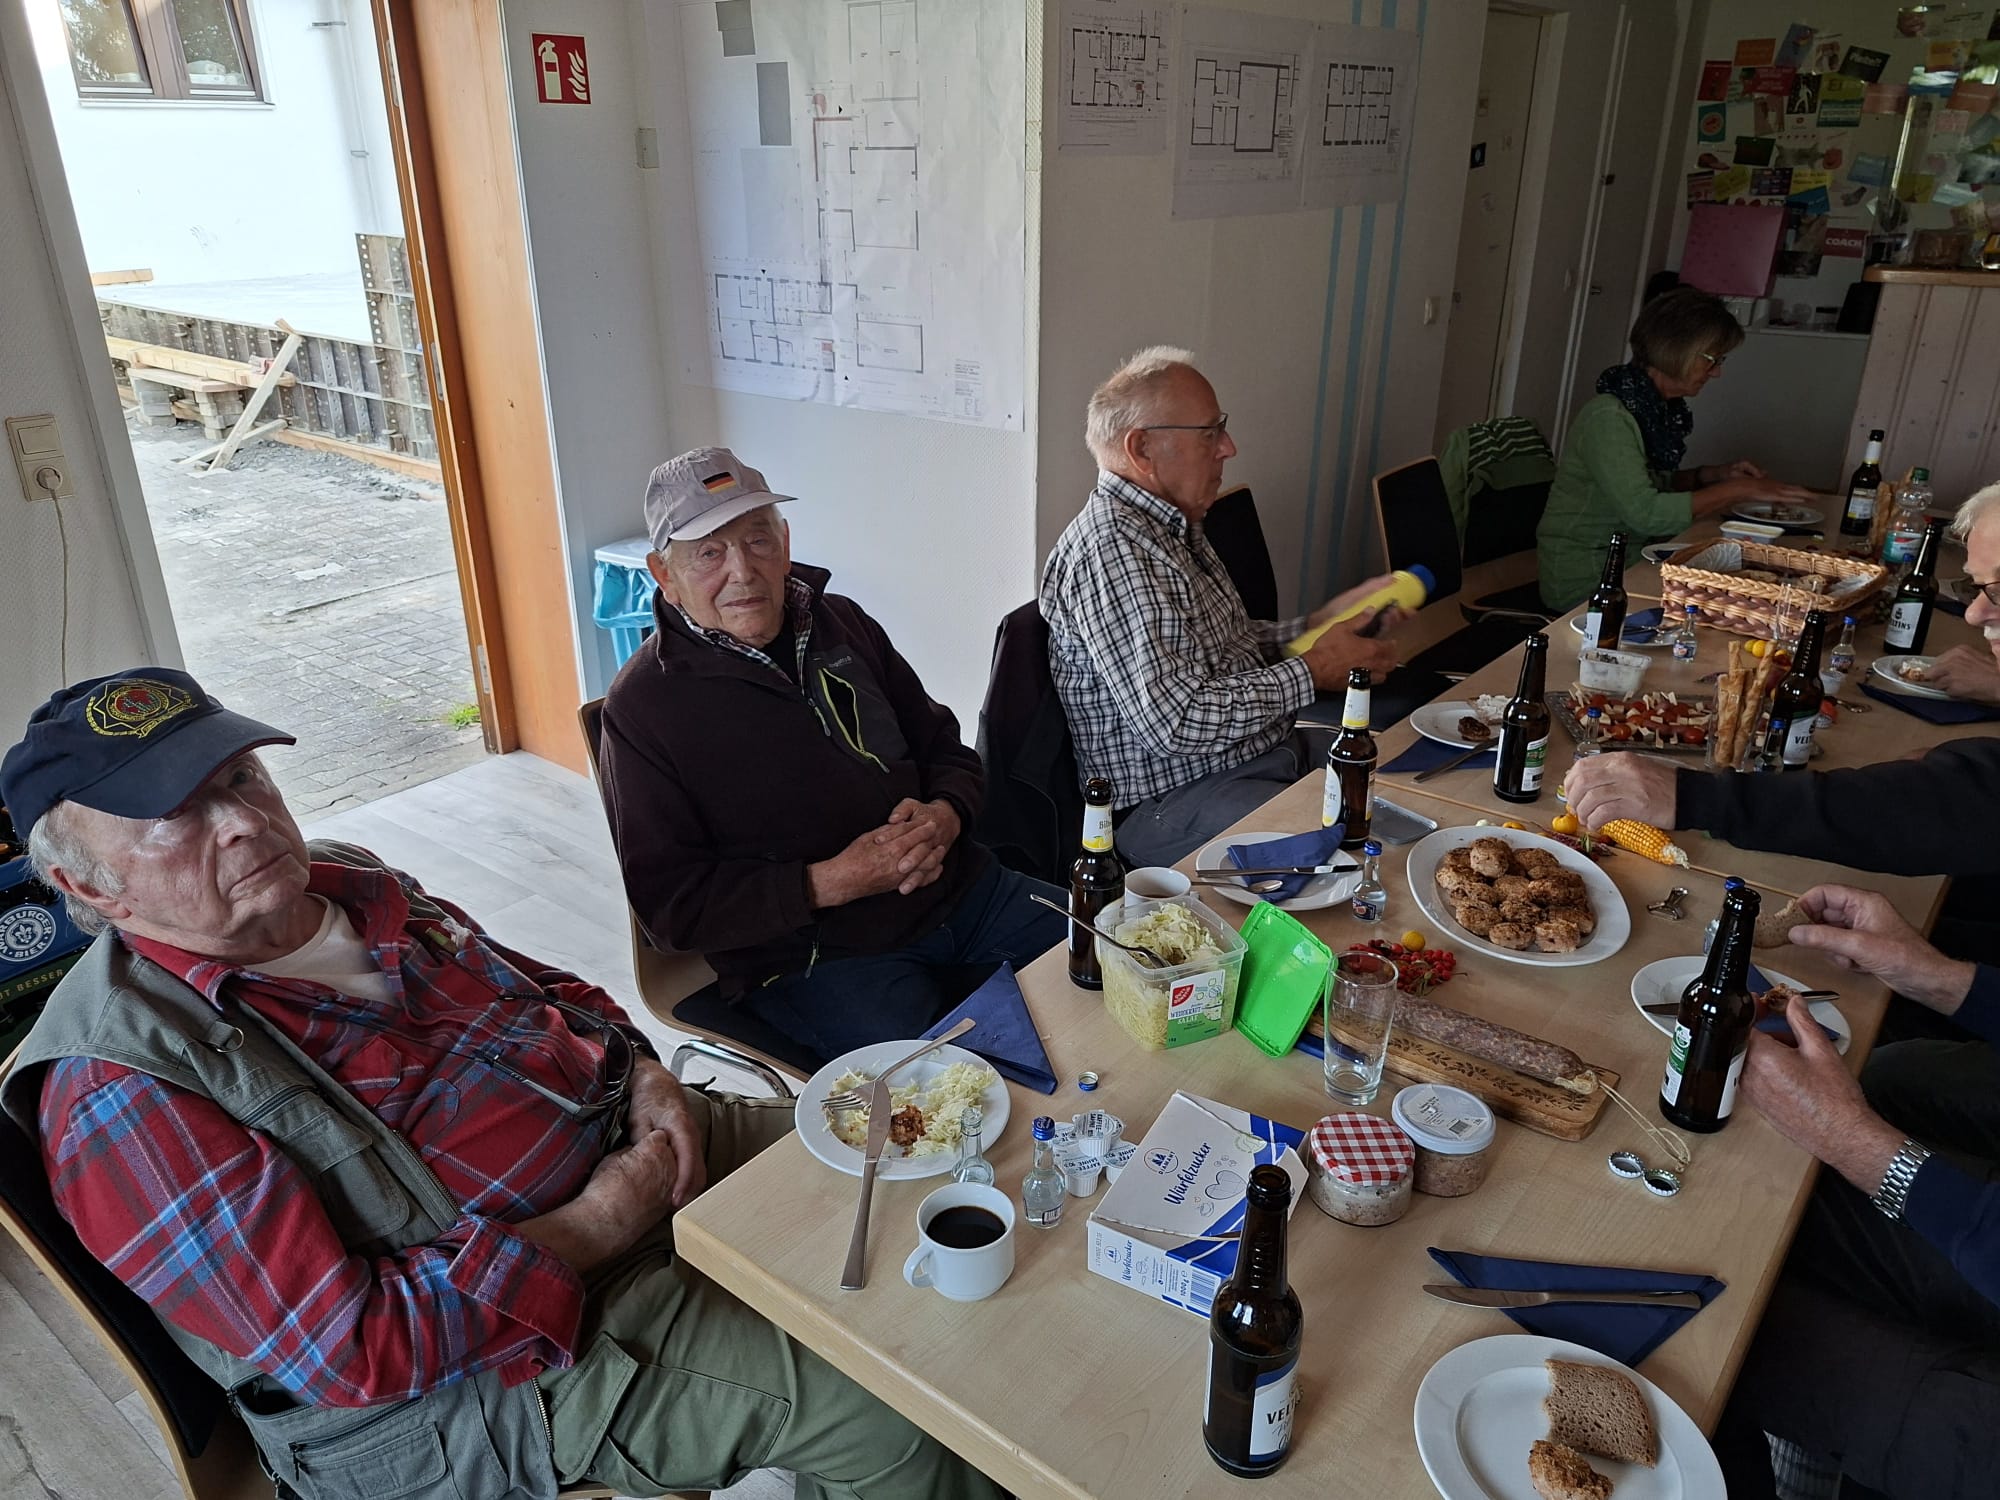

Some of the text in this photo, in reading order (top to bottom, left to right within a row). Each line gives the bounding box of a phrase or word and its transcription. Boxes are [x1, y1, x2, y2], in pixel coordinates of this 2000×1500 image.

[1825, 237, 1863, 248] COACH
[14, 941, 47, 958] BIER
[16, 969, 64, 992] BESSER
[1157, 1150, 1176, 1176] DIAMANT
[1163, 1141, 1212, 1205] Würfelzucker
[1121, 1240, 1133, 1281] Würfelzucker
